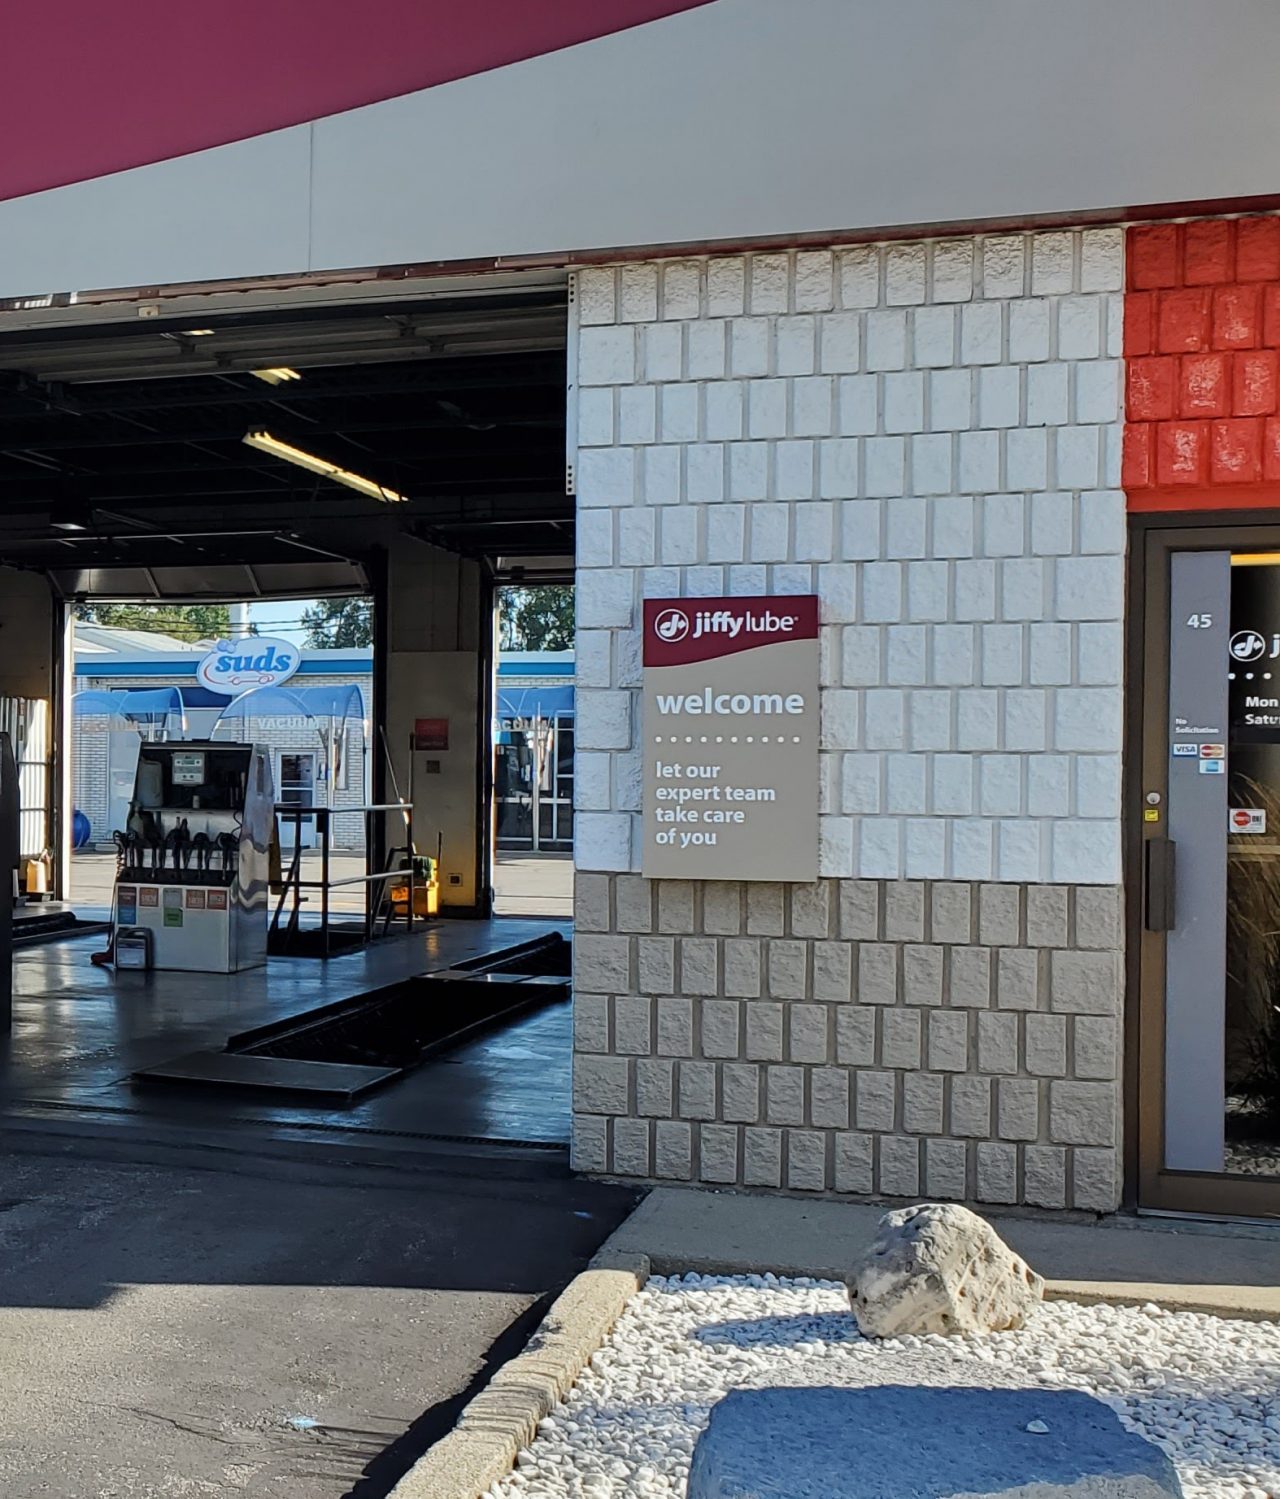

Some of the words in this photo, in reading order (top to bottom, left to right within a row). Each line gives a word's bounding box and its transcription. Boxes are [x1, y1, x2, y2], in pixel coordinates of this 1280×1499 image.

[1187, 614, 1212, 629] 45
[215, 646, 292, 673] suds
[656, 687, 804, 715] welcome
[1245, 696, 1279, 708] Mon
[1176, 745, 1196, 753] VISA
[656, 761, 681, 779] let
[686, 765, 721, 779] our
[656, 786, 721, 803] expert
[724, 786, 776, 802] team
[656, 806, 699, 823] take
[703, 809, 745, 823] care
[656, 828, 677, 845] of
[680, 831, 717, 848] you
